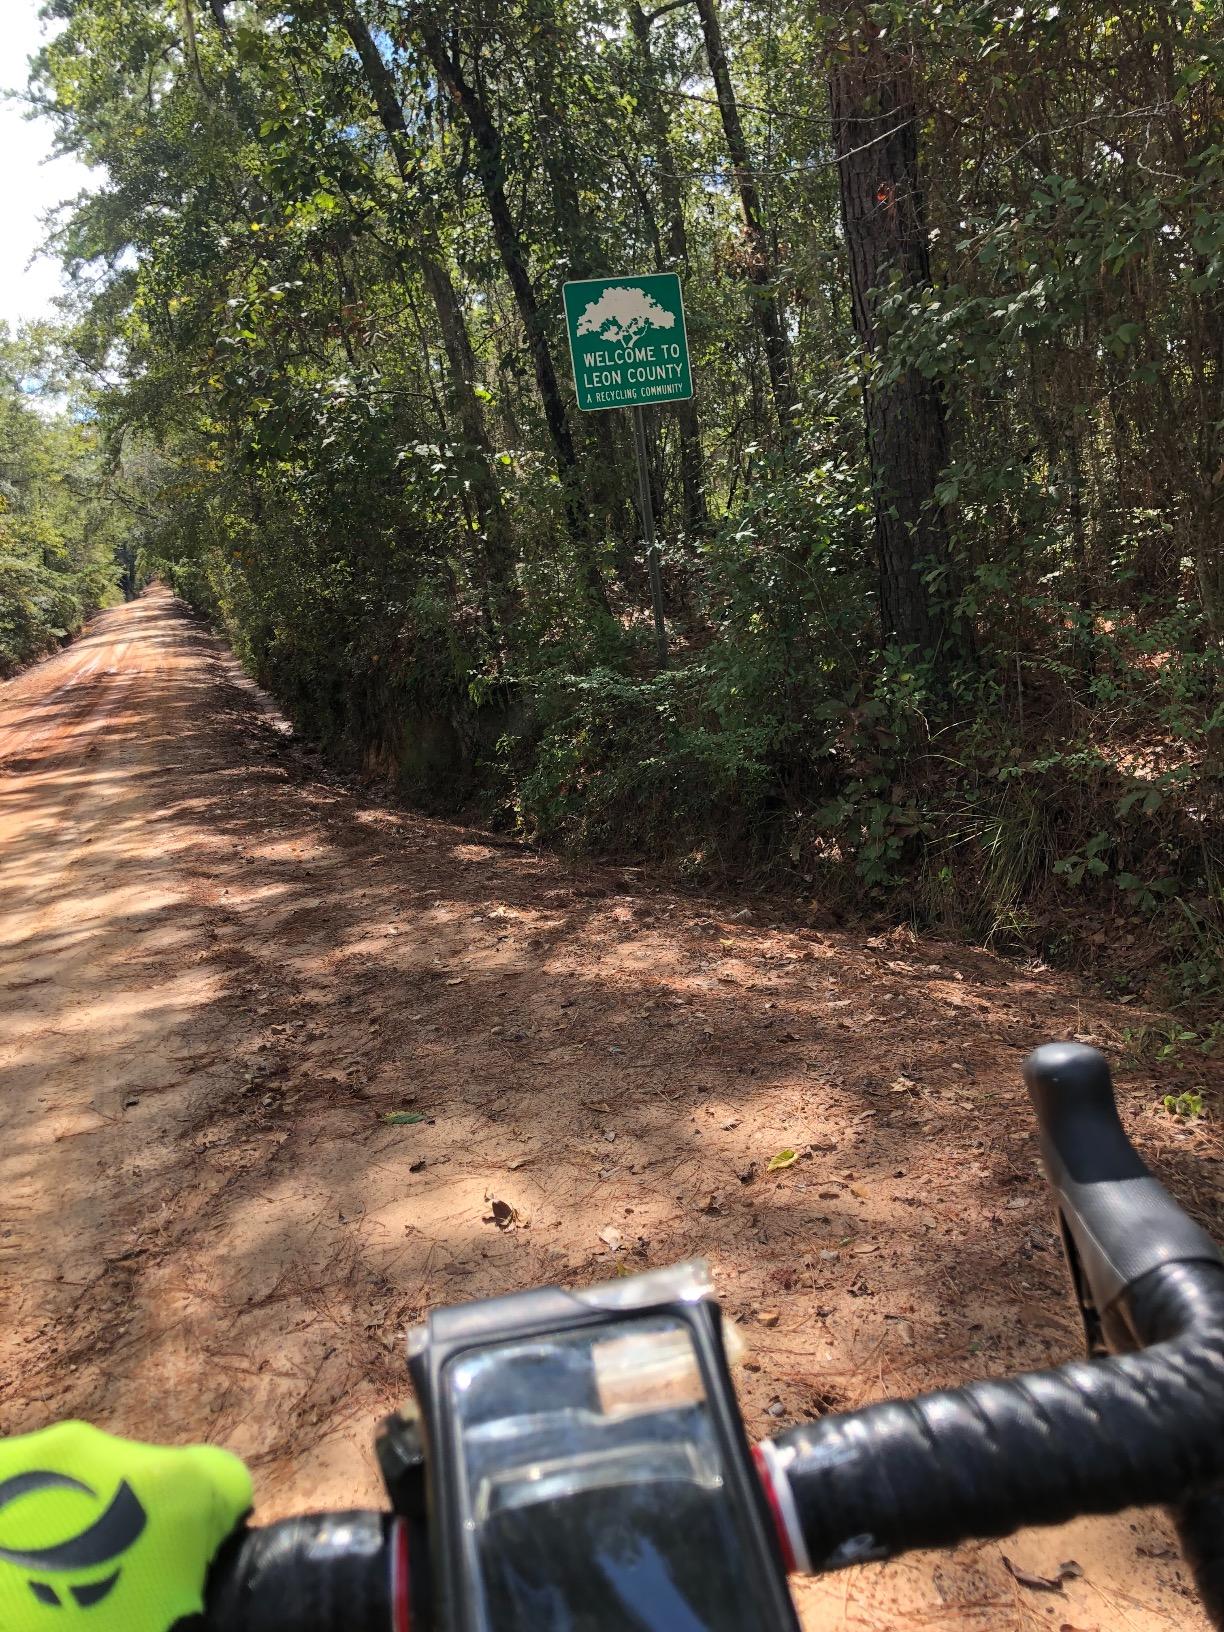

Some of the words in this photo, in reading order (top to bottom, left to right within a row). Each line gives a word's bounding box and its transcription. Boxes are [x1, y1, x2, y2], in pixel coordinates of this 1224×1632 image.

[583, 346, 656, 367] WELCOME
[661, 344, 680, 359] TO
[584, 370, 621, 388] LEON
[627, 363, 682, 382] COUNTY
[586, 394, 592, 403] A
[596, 388, 637, 402] RECYCLING
[641, 382, 683, 396] COMMUNITY
